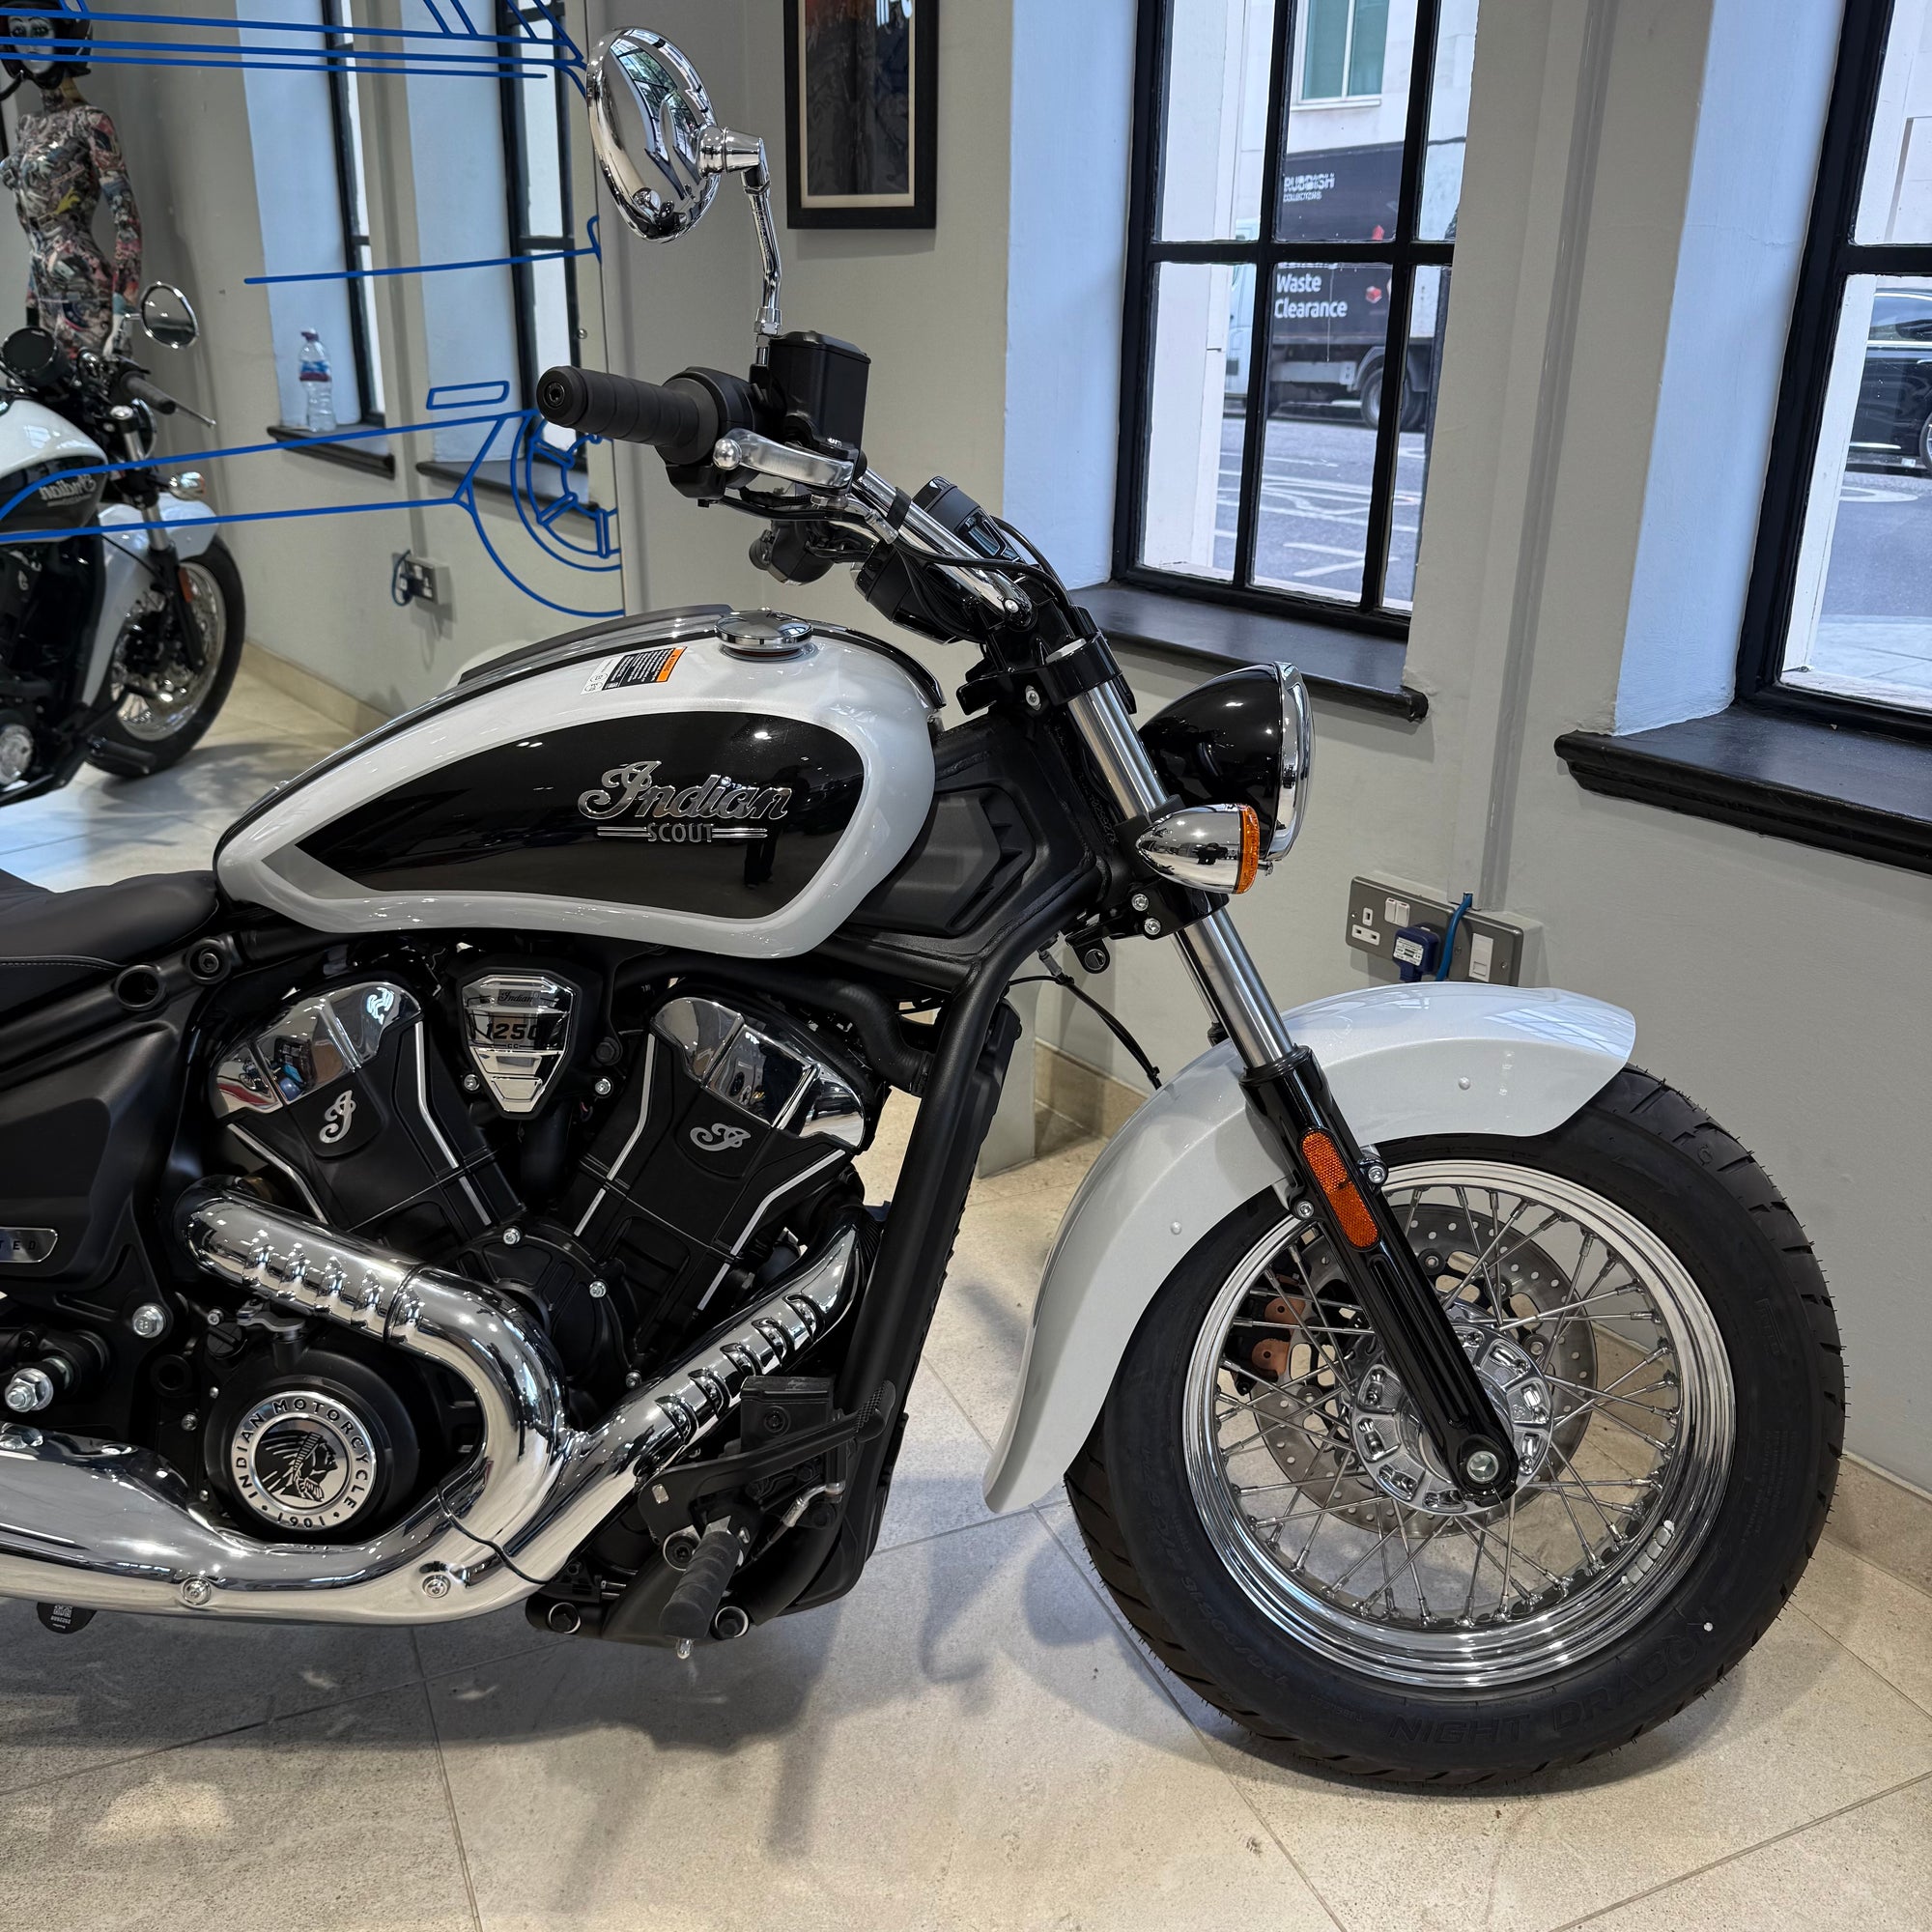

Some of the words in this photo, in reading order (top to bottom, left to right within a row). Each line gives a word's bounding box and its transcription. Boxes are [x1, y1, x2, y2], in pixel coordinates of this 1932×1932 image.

[1283, 173, 1335, 192] RUBBISH
[1276, 272, 1322, 293] Waste
[1274, 297, 1349, 319] Clearance
[578, 760, 792, 819] Indian
[646, 823, 714, 842] SCOUT
[497, 989, 534, 1003] Indian
[236, 1412, 267, 1499] INDIAN
[271, 1398, 369, 1509] MOTORCYCLE
[276, 1512, 327, 1528] 1901
[1389, 1713, 1530, 1746] NIGHT
